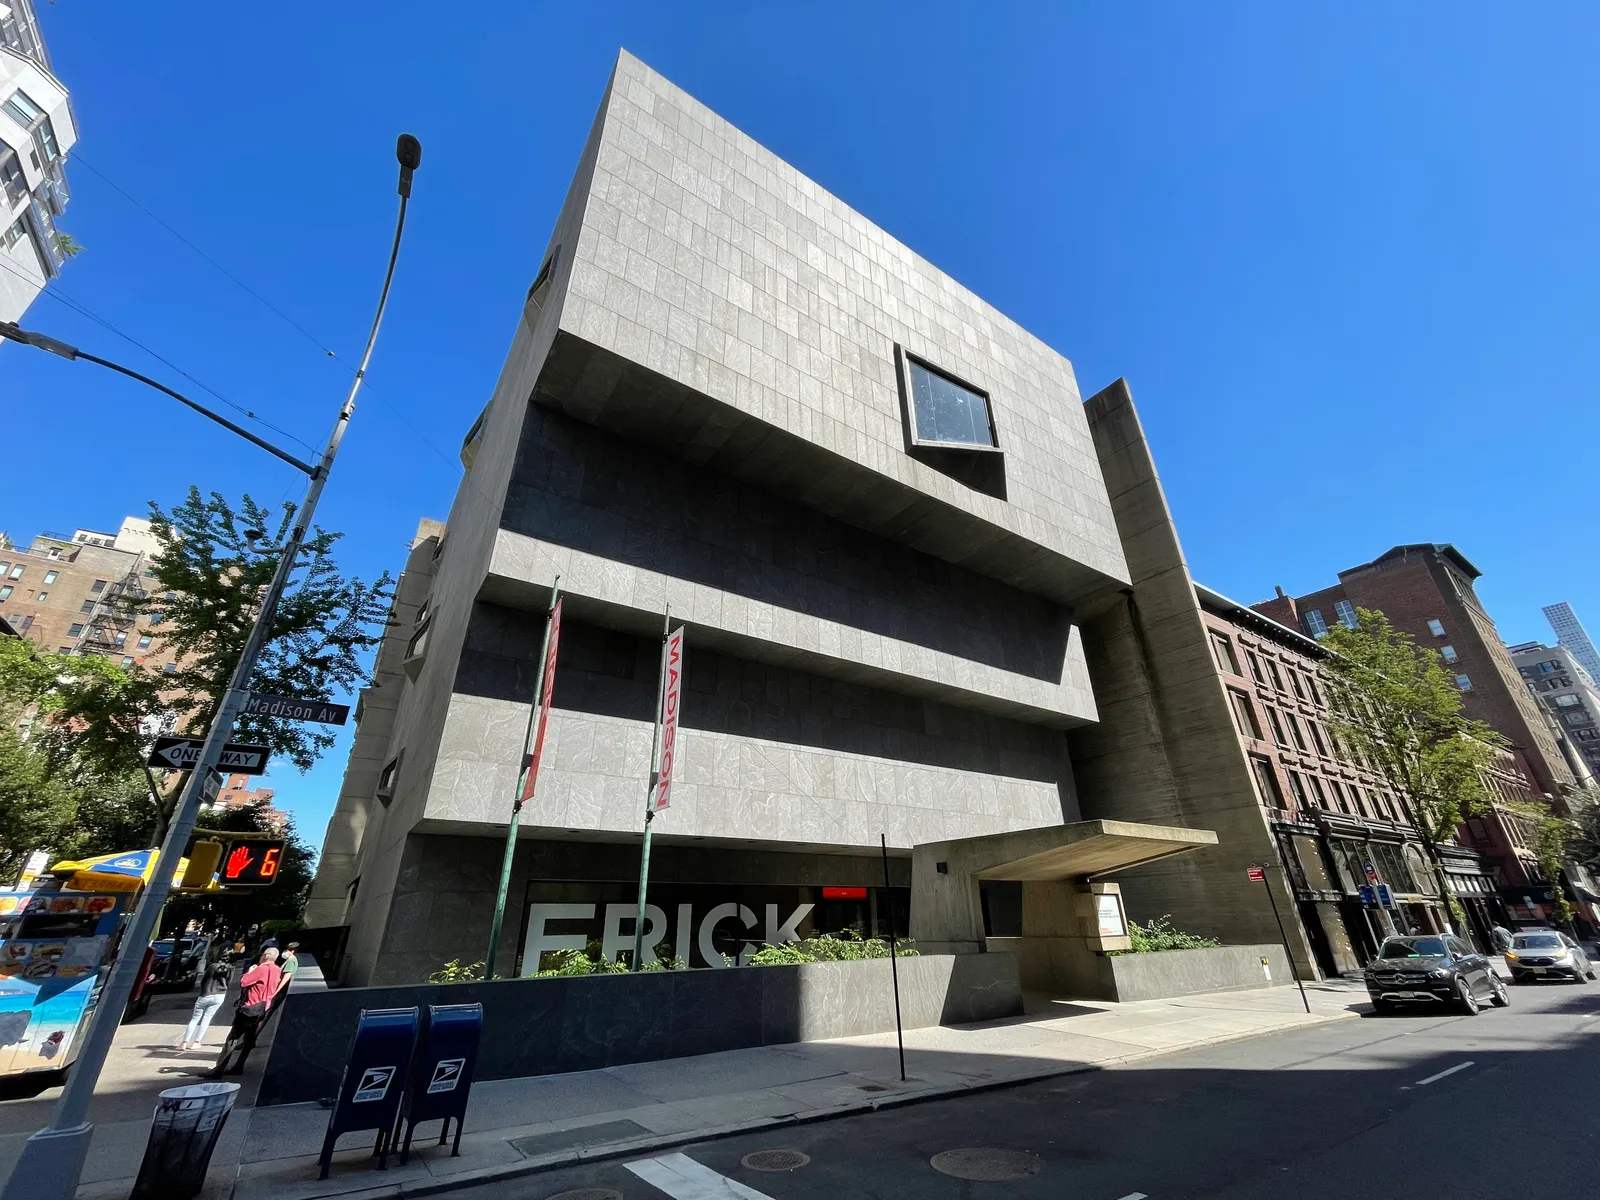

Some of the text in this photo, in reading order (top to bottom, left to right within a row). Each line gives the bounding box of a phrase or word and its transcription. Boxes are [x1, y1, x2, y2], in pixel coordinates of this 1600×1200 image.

[249, 699, 337, 722] Madison Av
[657, 635, 680, 806] MADISON
[170, 747, 255, 765] ONE WAY
[260, 848, 279, 876] 6
[520, 902, 816, 979] FRICK
